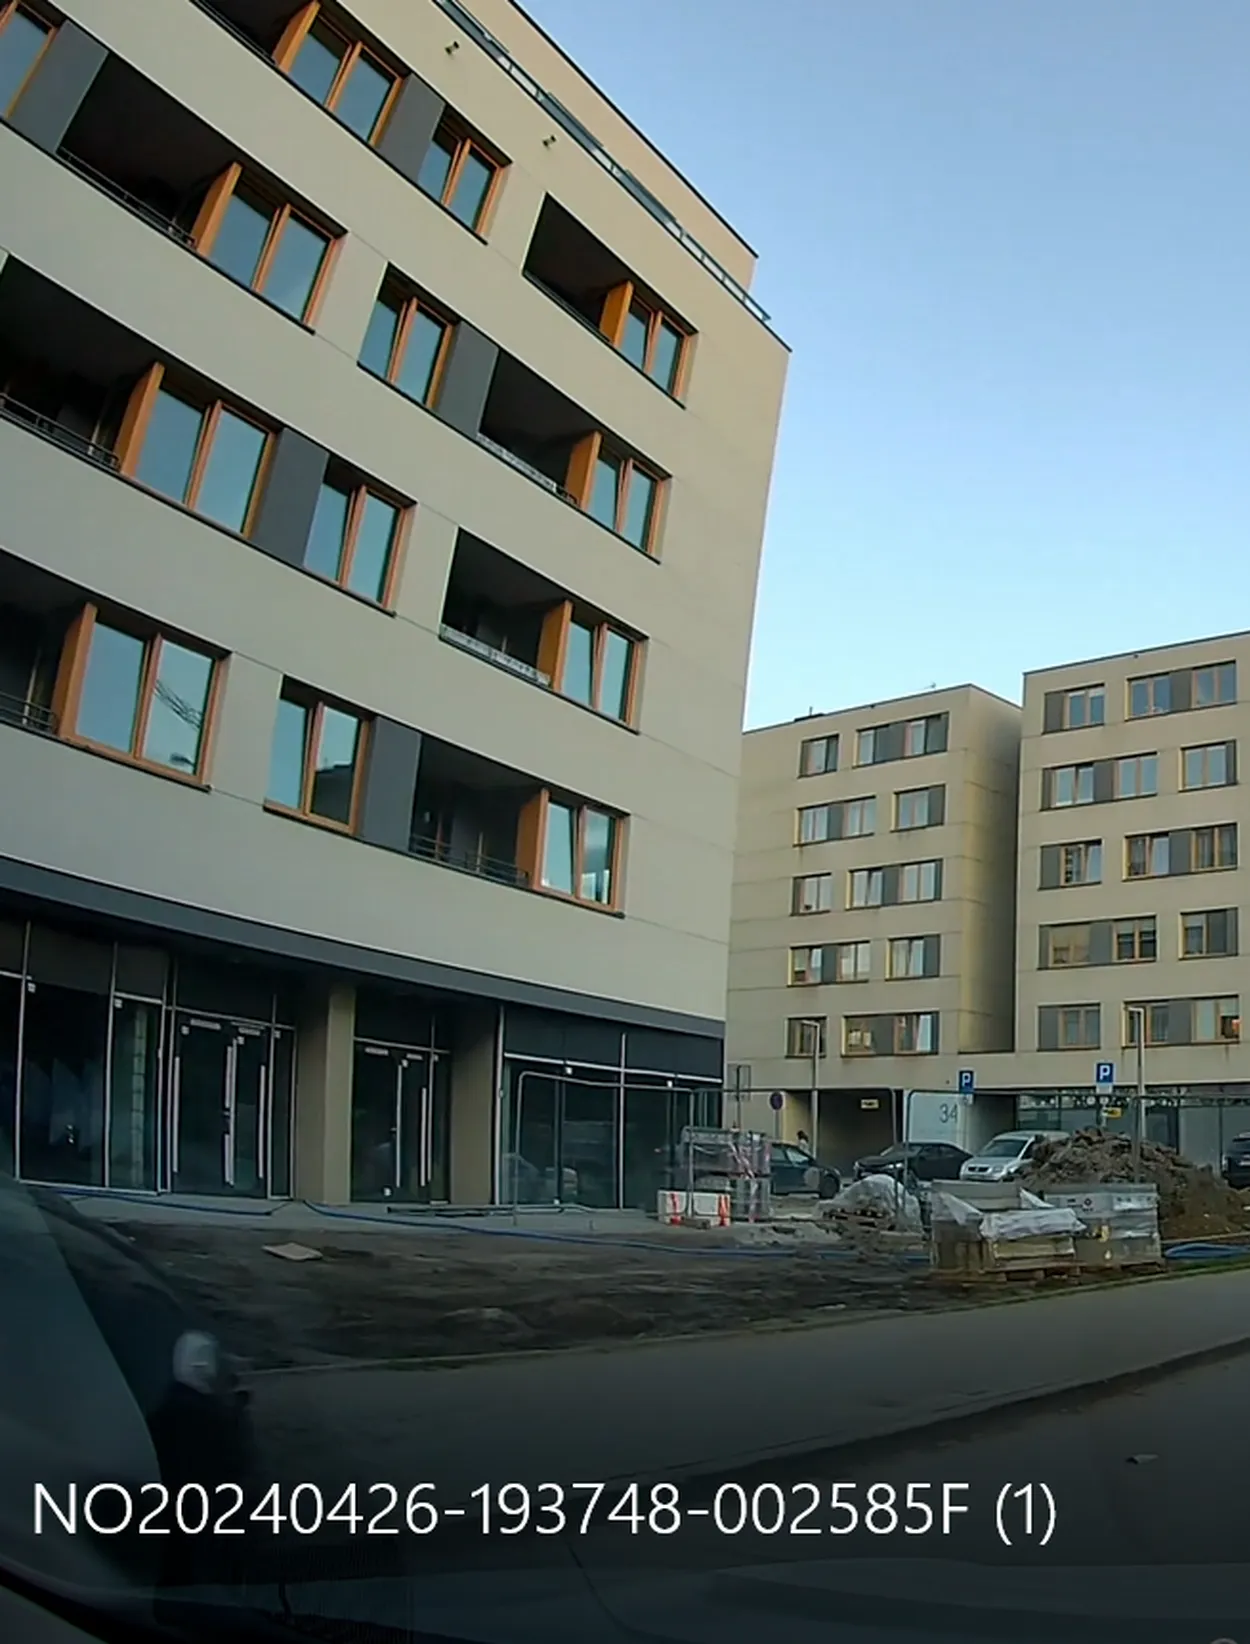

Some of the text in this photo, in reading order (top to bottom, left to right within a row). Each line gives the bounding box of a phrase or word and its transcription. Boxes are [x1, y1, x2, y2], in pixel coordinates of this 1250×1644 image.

[962, 1072, 971, 1086] P
[1100, 1065, 1110, 1080] P
[939, 1103, 958, 1124] 34
